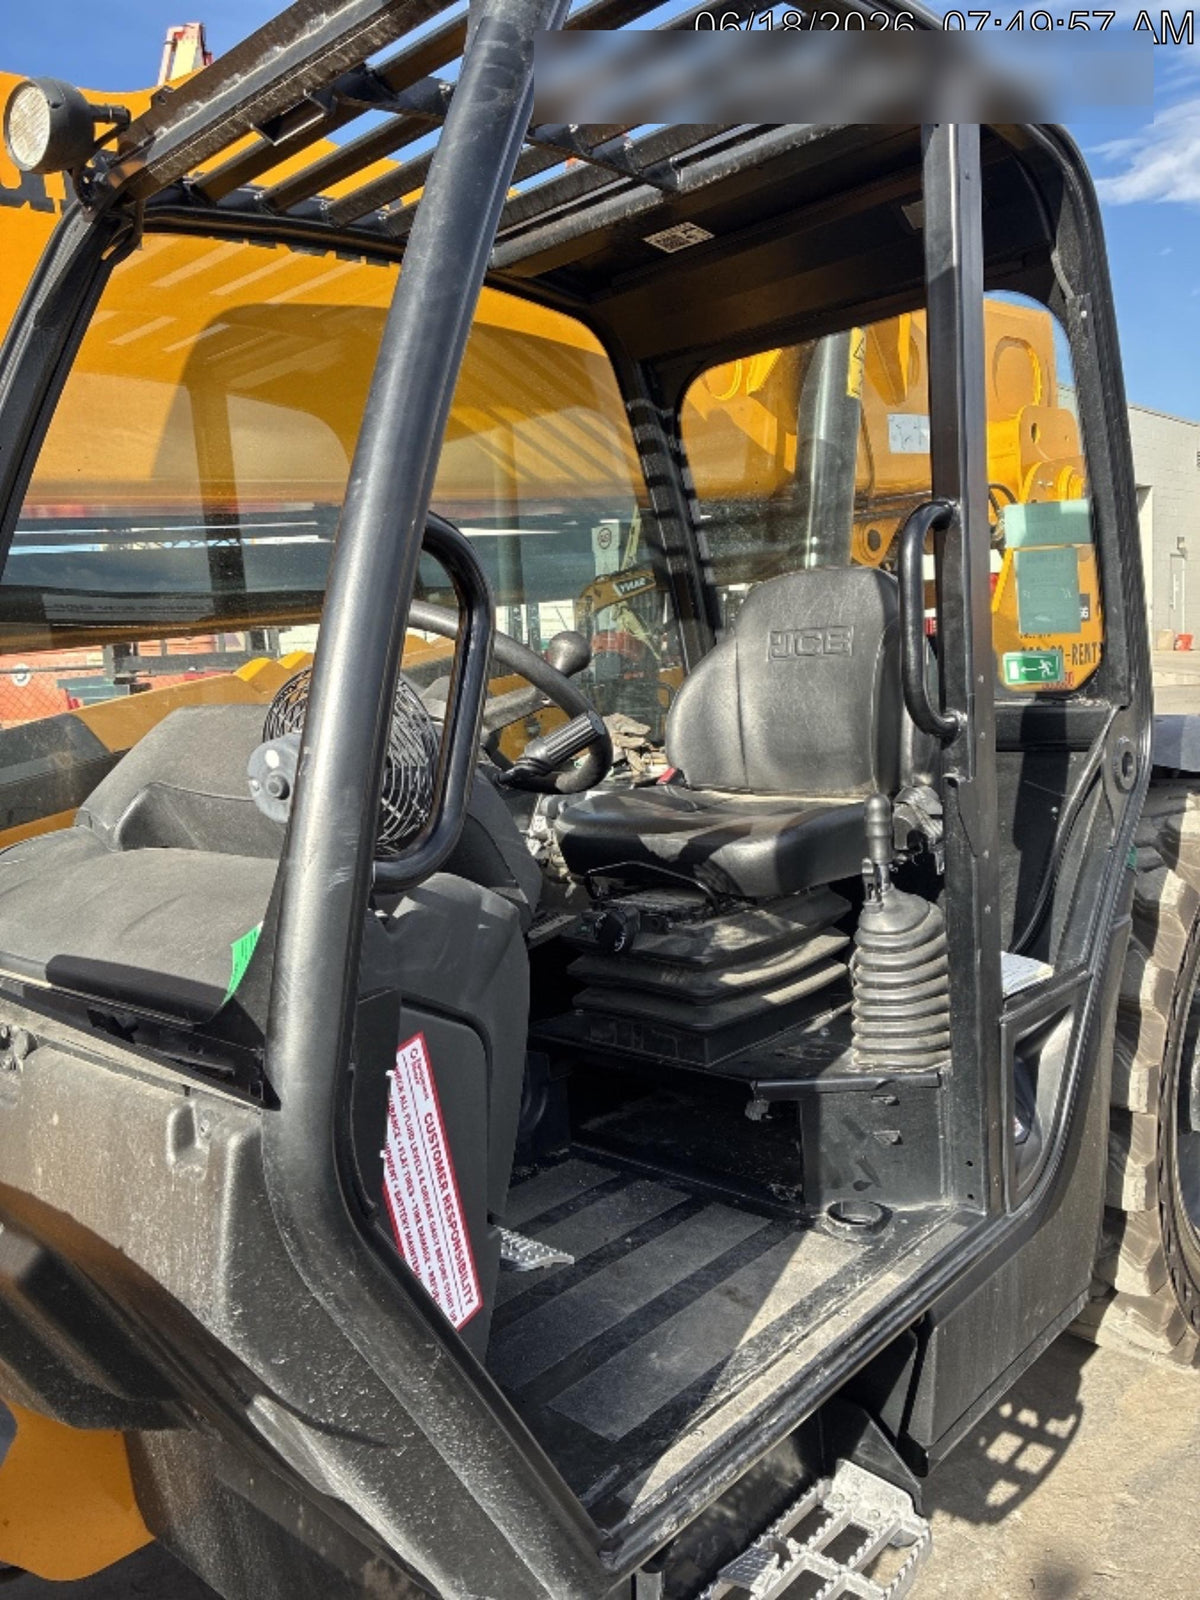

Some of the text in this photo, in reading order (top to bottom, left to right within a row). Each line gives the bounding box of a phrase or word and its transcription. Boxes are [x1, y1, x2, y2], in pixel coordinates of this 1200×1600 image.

[769, 627, 850, 659] JCB
[403, 1113, 415, 1141] FLUID
[410, 1141, 423, 1176] LEVELS
[421, 1186, 434, 1220] GREASE
[435, 1247, 448, 1281] BEFORE
[444, 1282, 455, 1309] START
[417, 1226, 431, 1263] DAMAGE
[424, 1113, 473, 1304] CUSTOMER RESPONSIBILITY
